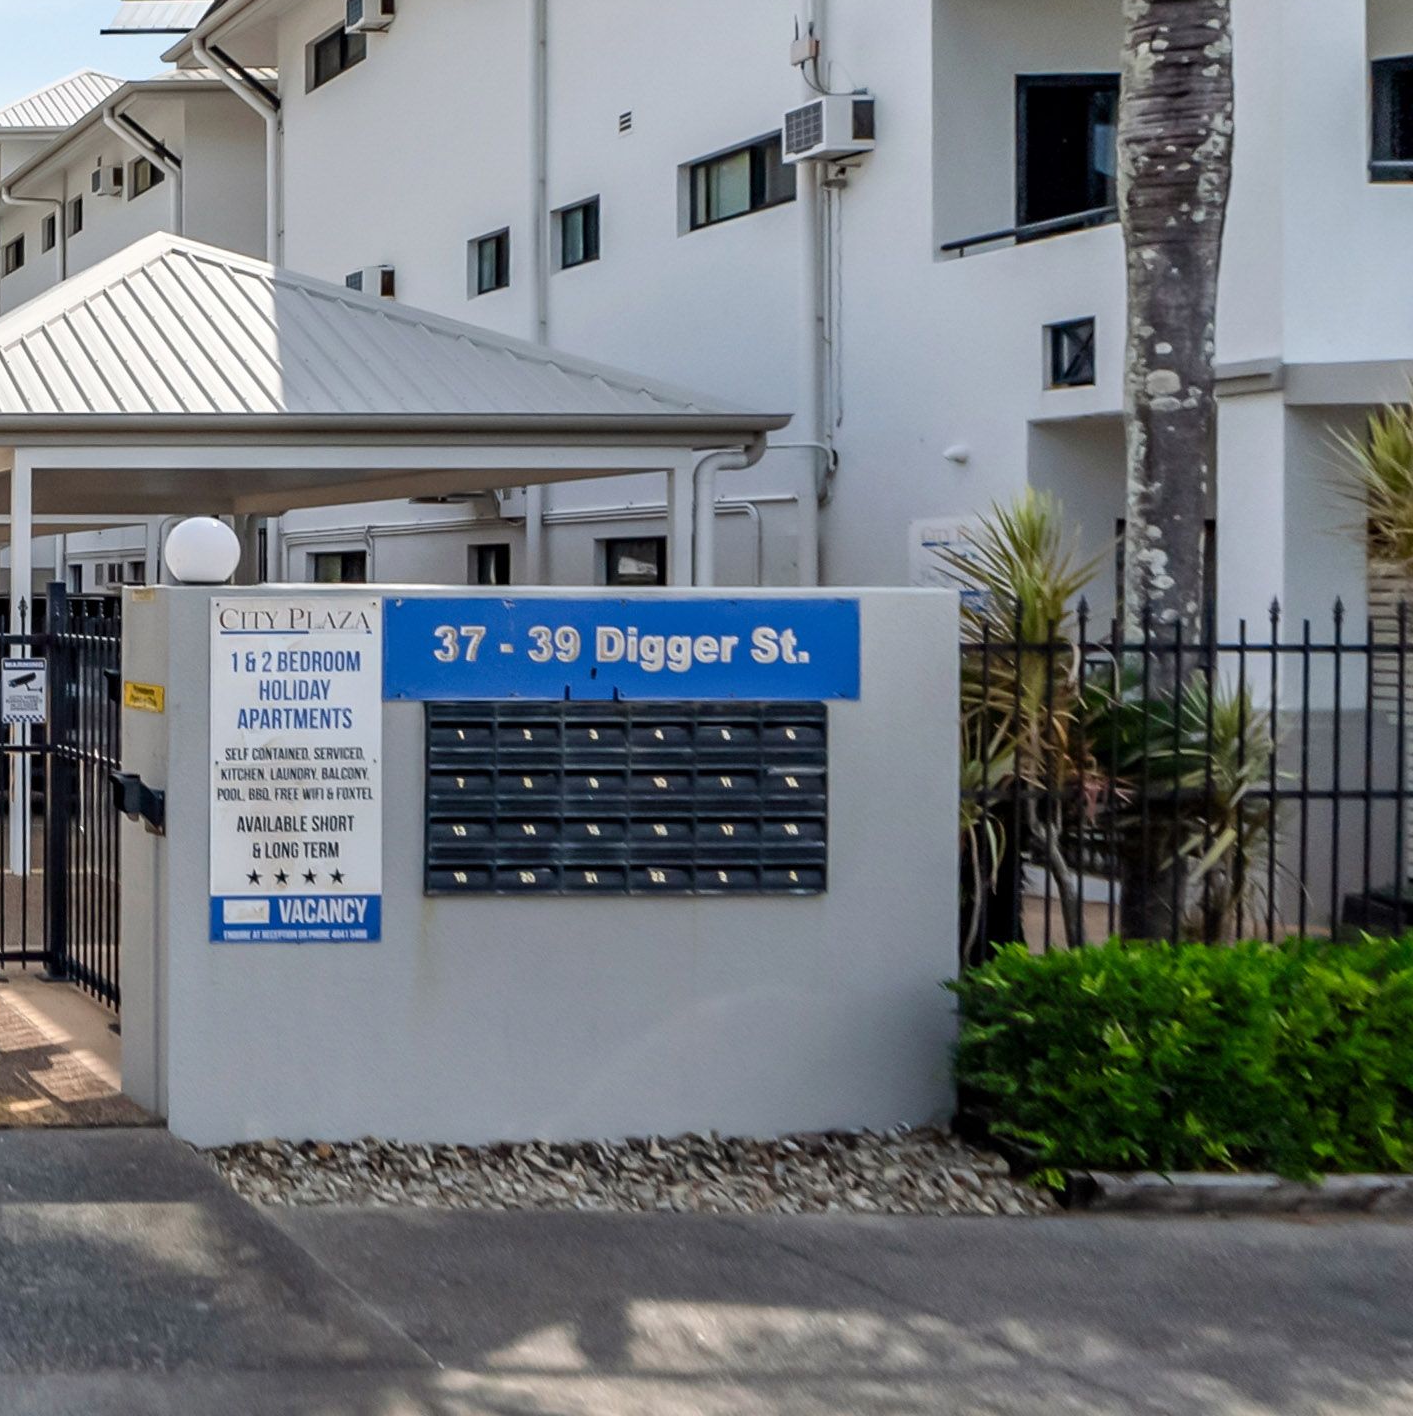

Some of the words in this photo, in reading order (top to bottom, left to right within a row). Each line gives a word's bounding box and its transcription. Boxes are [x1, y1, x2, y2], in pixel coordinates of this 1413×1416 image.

[219, 607, 279, 630] CITY
[288, 607, 371, 630] PLAZA
[433, 625, 487, 663] 37
[499, 642, 514, 654] -
[527, 625, 582, 663] 39
[596, 626, 739, 672] Digger
[750, 626, 810, 664] St.
[231, 651, 238, 673] 1
[245, 651, 256, 672] &
[262, 651, 272, 672] 2
[277, 651, 361, 672] BEDROOM
[259, 679, 331, 701] HOLIDAY
[237, 708, 353, 730] APARTMENTS
[457, 730, 465, 740] 1
[523, 729, 533, 741] 2
[225, 747, 249, 761] SELF
[720, 776, 733, 788] 11
[274, 787, 299, 800] FREE
[302, 787, 324, 800] WIFI
[326, 787, 334, 800] &
[336, 787, 373, 800] FOXTEL
[237, 815, 308, 833] AVAILABLE
[311, 815, 355, 832] SHORT
[252, 842, 261, 859] &
[265, 841, 299, 859] LONG
[303, 841, 340, 859] TERM
[278, 898, 368, 924] VACANCY
